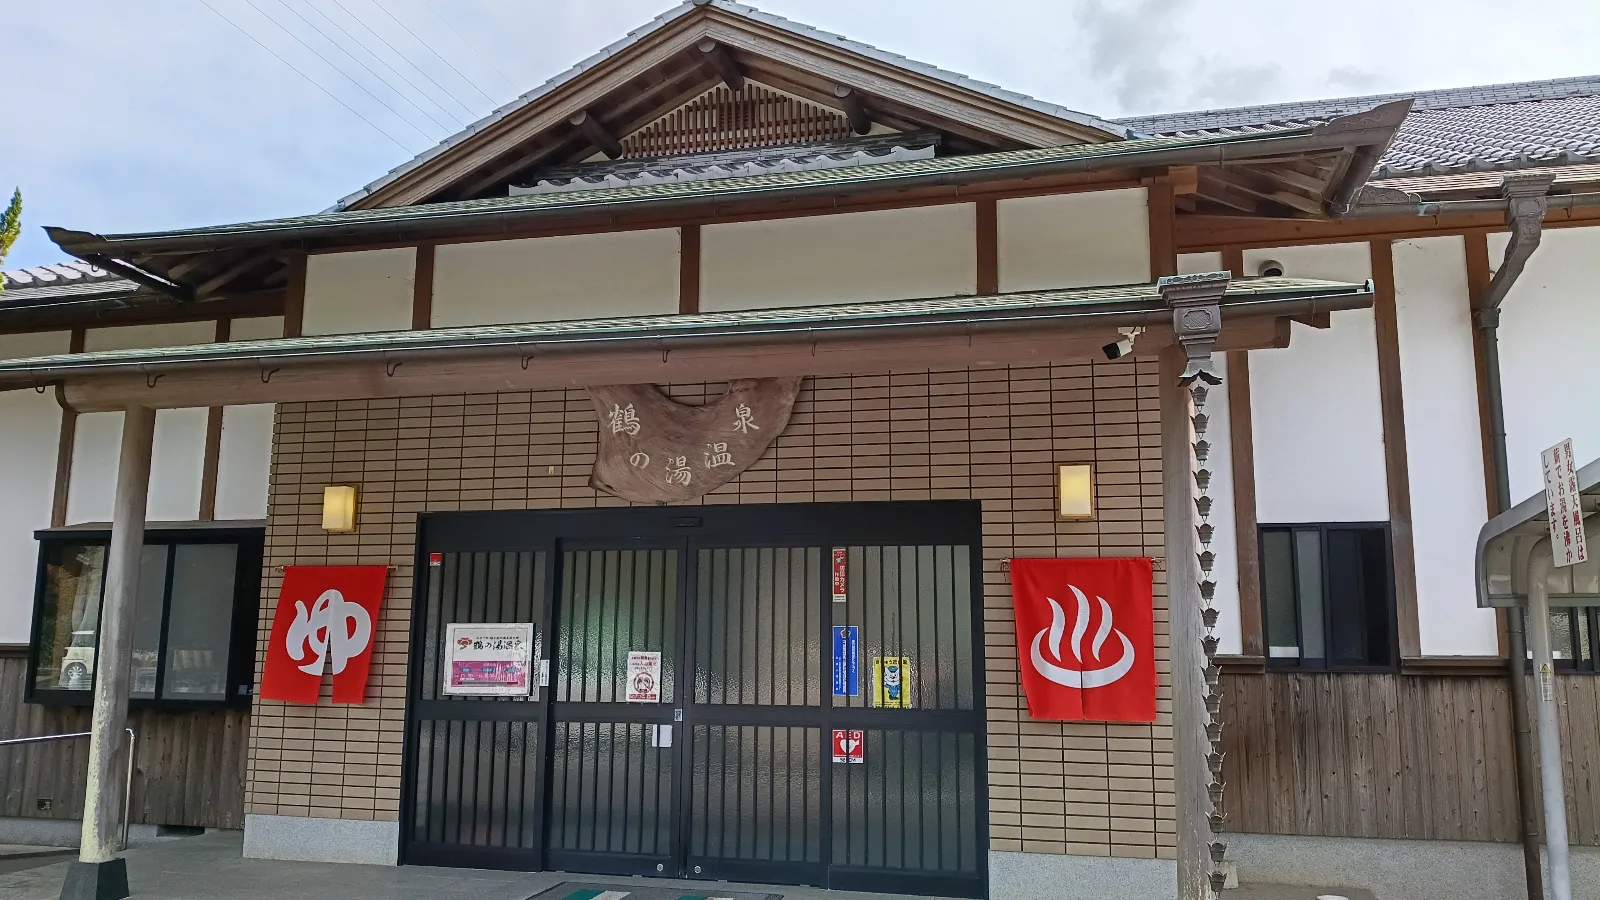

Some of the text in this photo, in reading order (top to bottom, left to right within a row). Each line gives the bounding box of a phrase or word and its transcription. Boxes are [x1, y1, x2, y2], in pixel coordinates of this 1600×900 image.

[608, 403, 759, 486] 鶴の湯温泉
[1543, 454, 1559, 540] しています。
[1563, 442, 1585, 561] 男女露天風呂は
[285, 589, 372, 676] ゆ
[836, 731, 860, 739] AED
